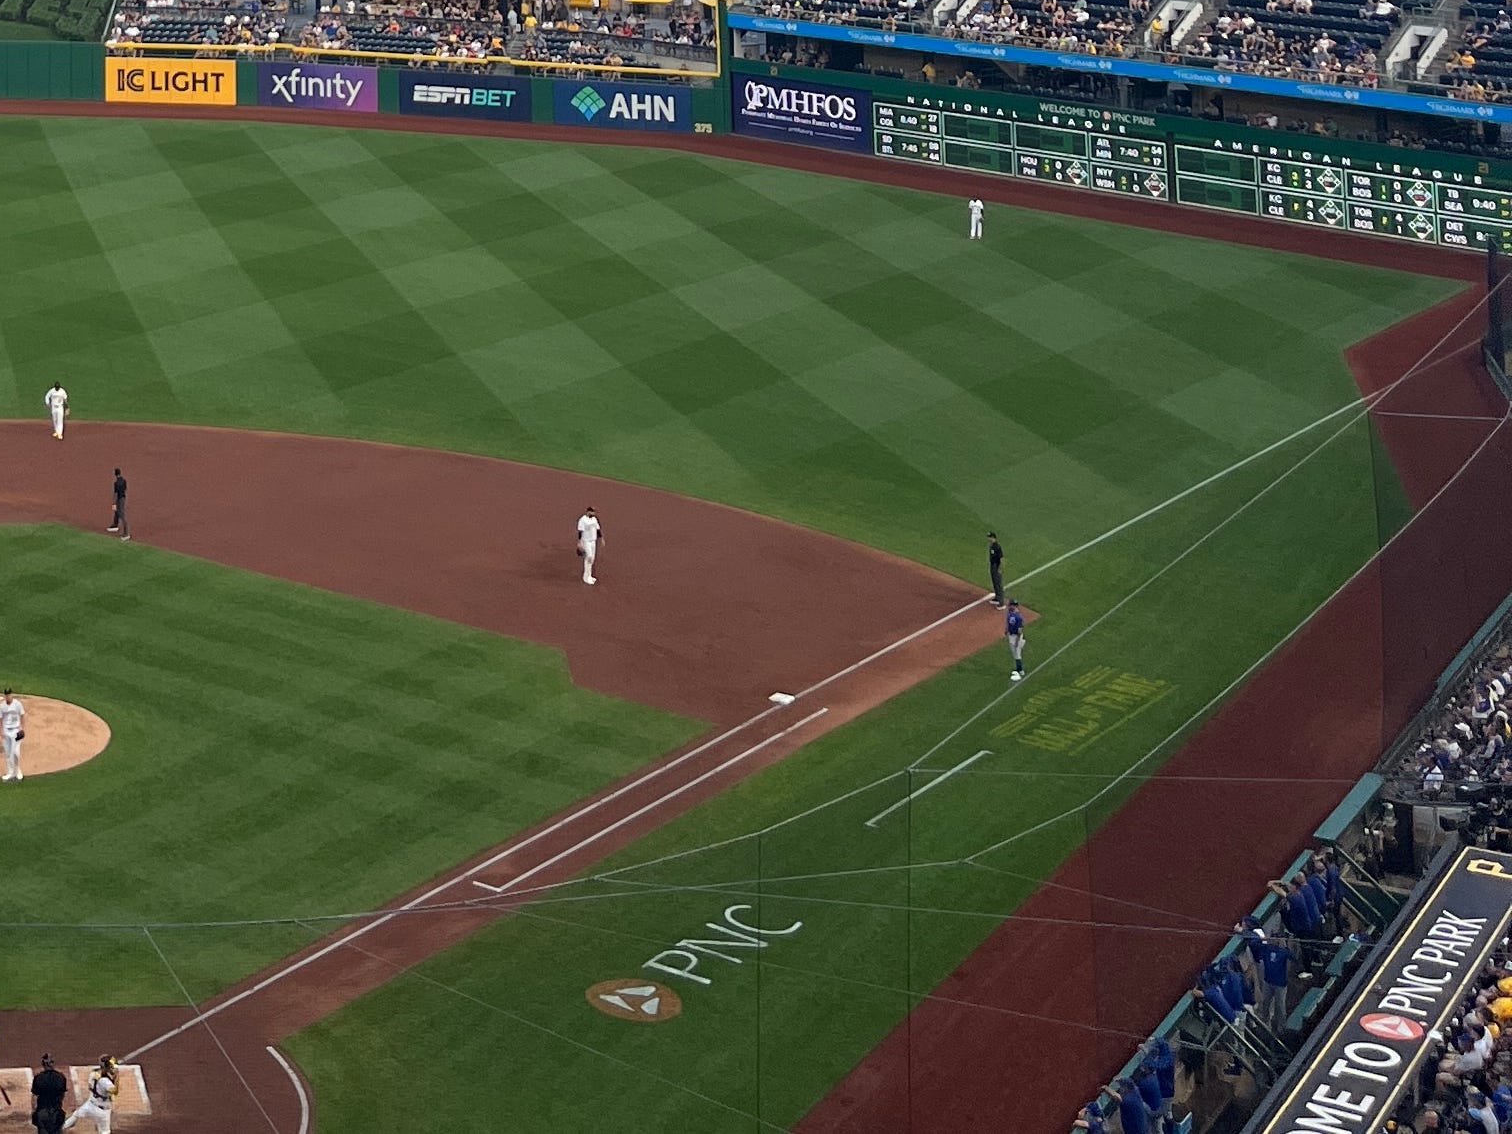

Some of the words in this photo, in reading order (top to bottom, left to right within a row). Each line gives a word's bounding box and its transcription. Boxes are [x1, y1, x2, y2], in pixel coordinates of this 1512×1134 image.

[117, 68, 144, 92] IC
[150, 71, 225, 92] LIGHT
[271, 67, 364, 107] xfinity
[609, 93, 675, 123] AHN
[907, 96, 1018, 119] NATIONAL
[1038, 114, 1126, 134] LEAGUE
[1039, 102, 1086, 117] WELCOME
[1088, 108, 1101, 119] TO
[1112, 112, 1131, 124] PNC
[1133, 115, 1156, 127] PARK
[1096, 138, 1110, 148] ATL
[1020, 156, 1037, 166] HOU
[1214, 139, 1351, 166] AMERICAN
[1376, 162, 1482, 185] LEAGUE
[1096, 167, 1113, 177] NYY
[1267, 163, 1281, 173] KC
[1304, 168, 1311, 177] 2
[1266, 174, 1282, 185] CLE
[1305, 180, 1312, 189] 3
[1352, 175, 1371, 185] TOR
[1268, 194, 1282, 204] KC
[1352, 187, 1372, 198] BOS
[1447, 189, 1459, 198] TB
[1268, 205, 1284, 216] CLE
[1307, 211, 1314, 220] 3
[1354, 207, 1373, 217] TOR
[1444, 201, 1464, 212] SEA
[1446, 221, 1464, 231] DET
[1444, 232, 1468, 245] CWS
[641, 904, 803, 985] PNC
[1411, 909, 1487, 966] PARK
[1377, 964, 1452, 1016] PNC
[1329, 1041, 1402, 1083] TO
